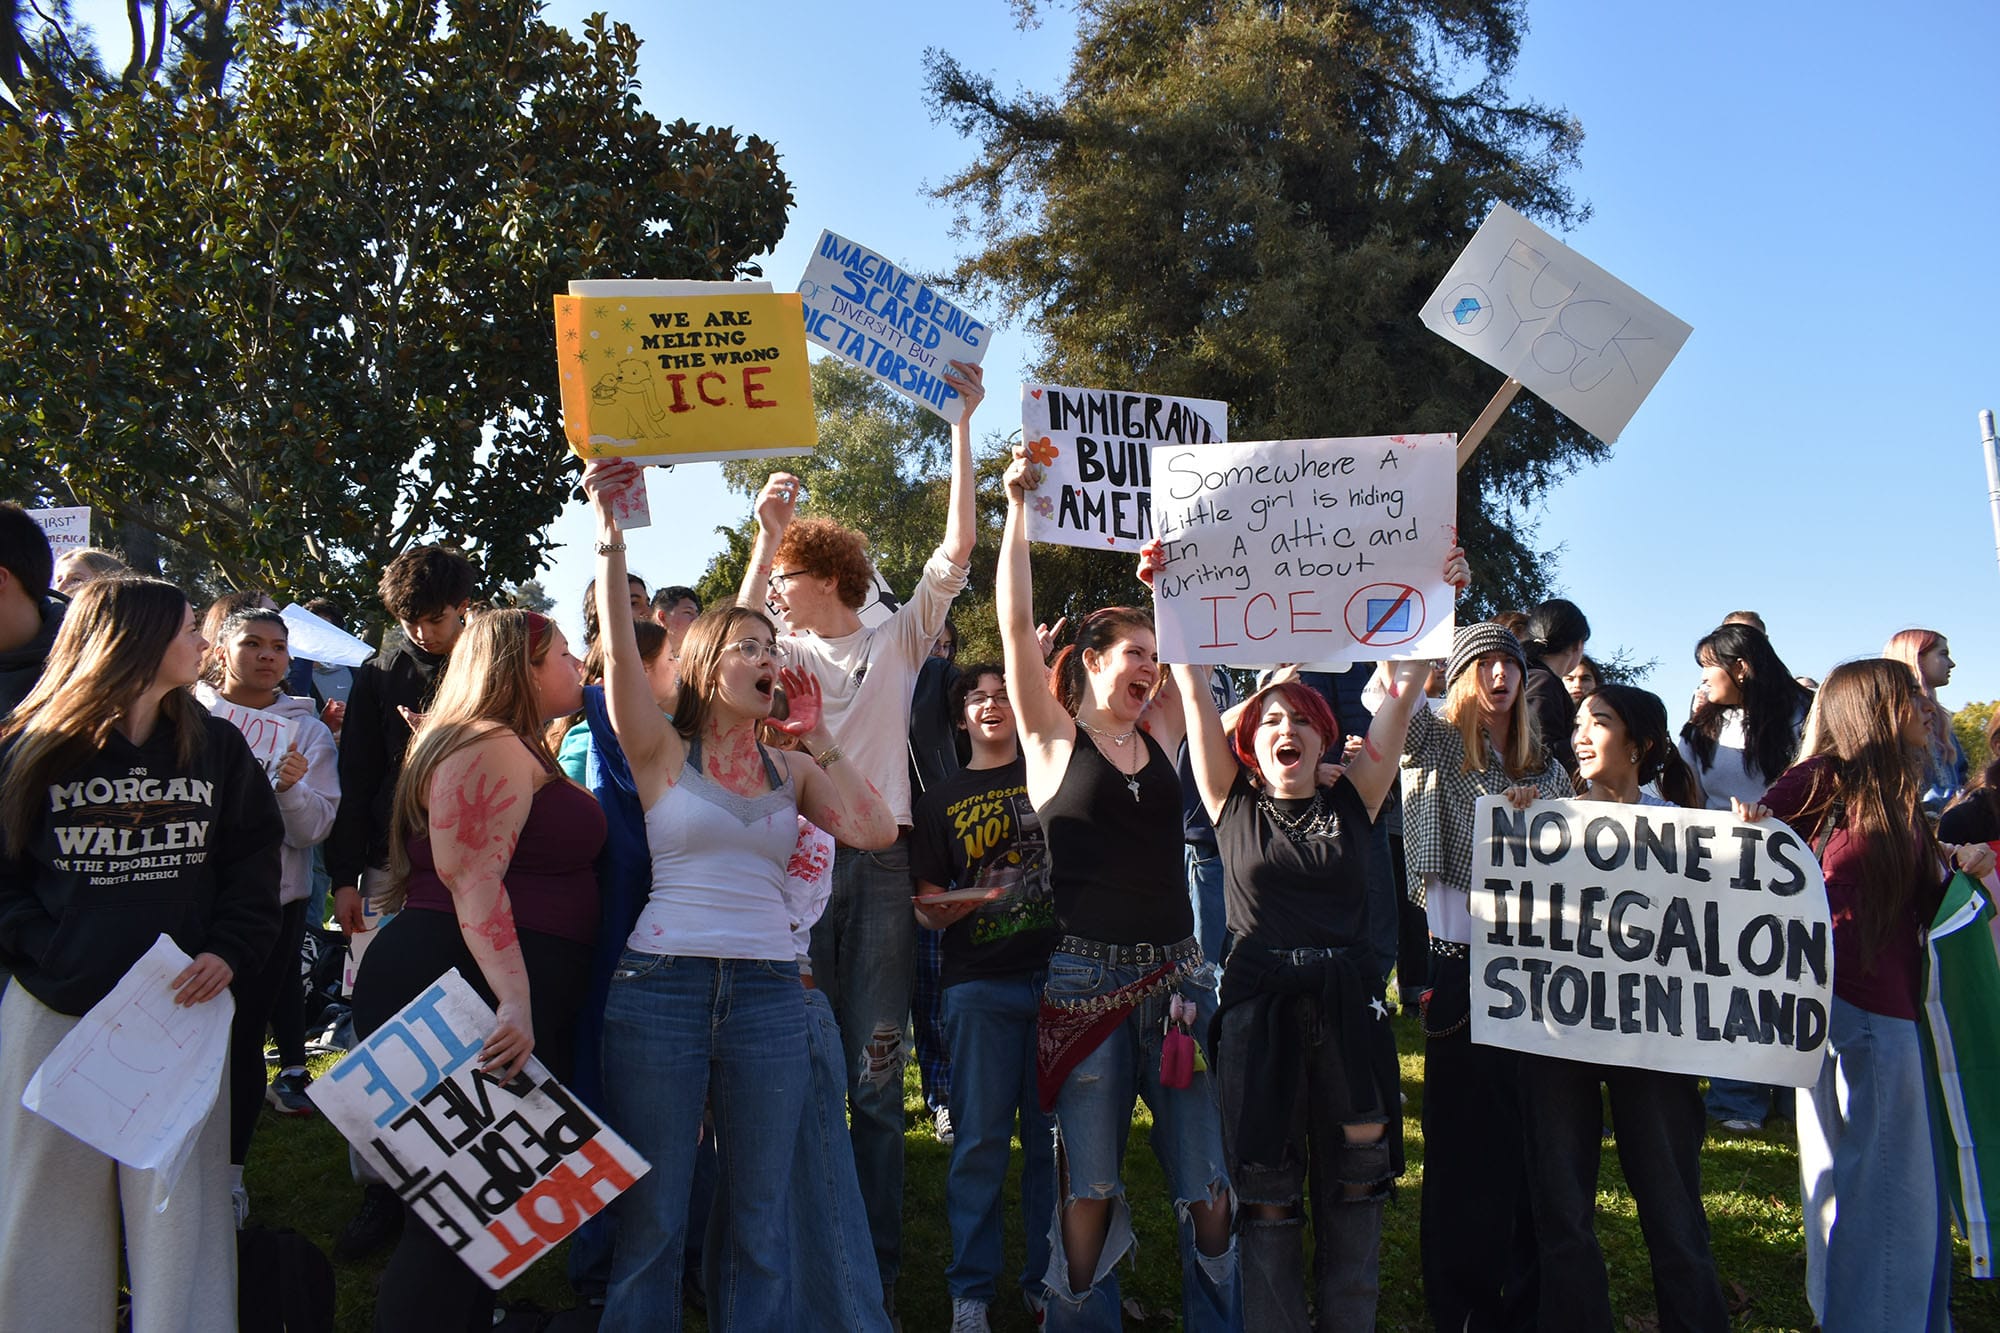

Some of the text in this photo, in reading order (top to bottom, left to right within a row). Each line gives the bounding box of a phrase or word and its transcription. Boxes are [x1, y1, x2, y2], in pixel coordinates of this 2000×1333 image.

[820, 233, 985, 348] IMAGINE BEING
[831, 270, 941, 350] SCARED
[1488, 238, 1655, 385] FUCK
[640, 330, 746, 350] MELTING
[649, 310, 752, 328] WE ARE
[798, 280, 969, 380] OF DIVERSITY BUT NO
[1499, 293, 1614, 393] YOU
[658, 346, 780, 369] THE WRONG
[1047, 390, 1223, 444] IMMIGRANT
[1076, 436, 1151, 488] BUIL
[1168, 449, 1398, 500] Somewhere A
[1058, 485, 1154, 540] AMER
[1164, 485, 1404, 534] Little girl is hiding
[47, 535, 86, 543] MERICA
[1160, 517, 1419, 566] In A attic and
[1274, 552, 1376, 577] about
[1199, 590, 1333, 649] ICE
[50, 777, 215, 812] MORGAN
[954, 799, 1005, 840] SAYS
[987, 785, 1027, 800] ROSEN
[54, 821, 209, 856] WALLEN
[73, 859, 105, 872] THE
[108, 854, 182, 873] PROBLEM
[964, 814, 1011, 868] NO!
[1490, 807, 1807, 897] NO ONE IS
[90, 870, 179, 886] NORTH AMERICA
[1484, 878, 1828, 988] ILLEGAL ON
[1483, 956, 1827, 1052] STOLEN LAND
[330, 985, 485, 1129] ICE
[371, 1068, 537, 1199] MELT
[408, 1077, 602, 1251] PEOPLE
[486, 1138, 637, 1280] HOT
